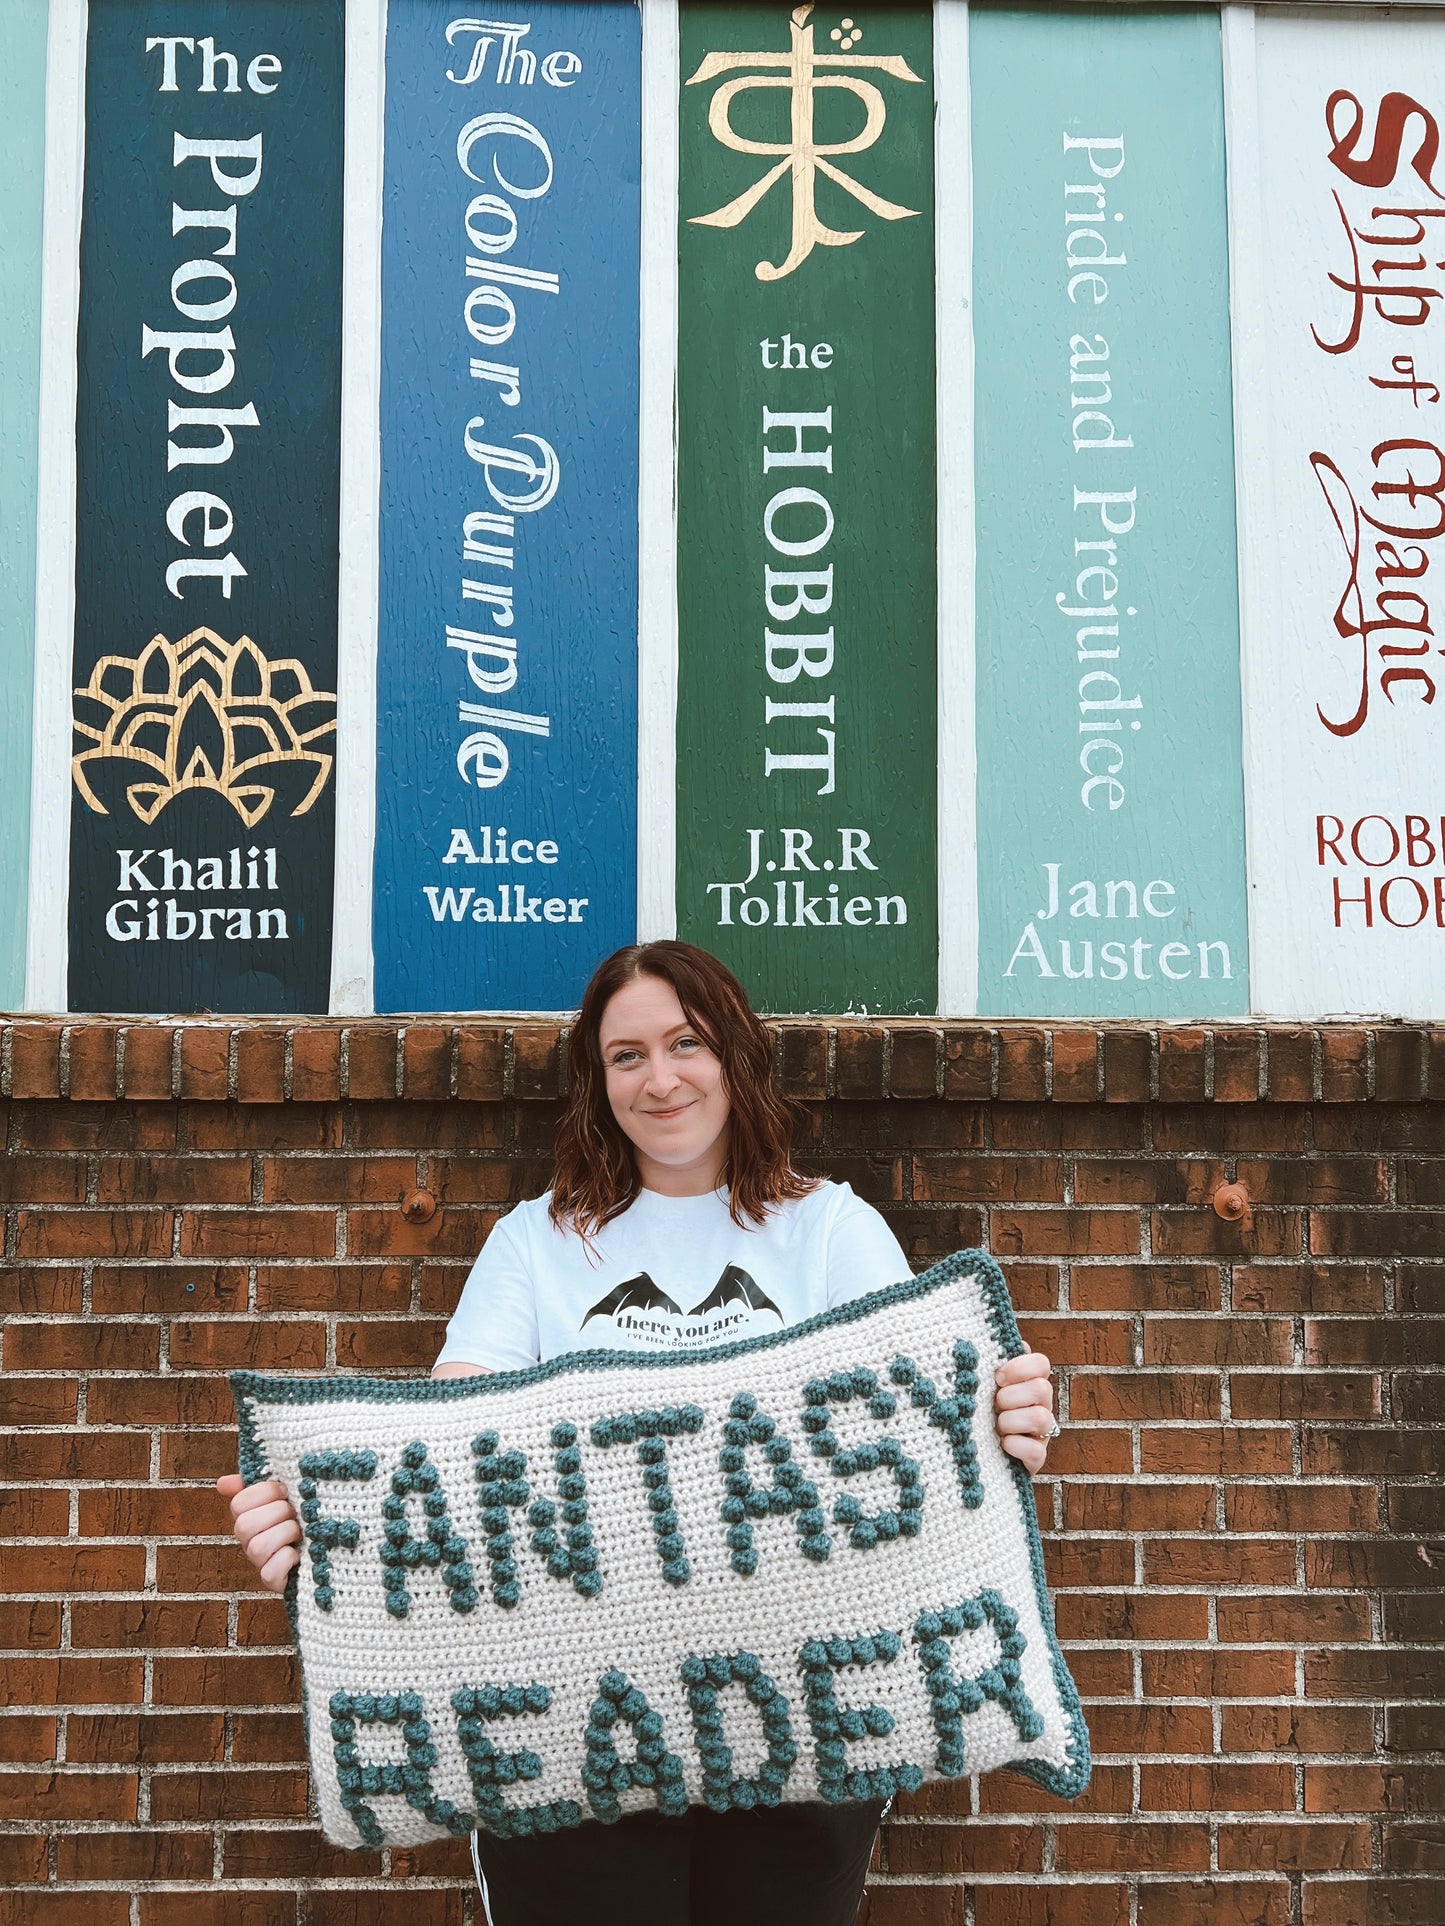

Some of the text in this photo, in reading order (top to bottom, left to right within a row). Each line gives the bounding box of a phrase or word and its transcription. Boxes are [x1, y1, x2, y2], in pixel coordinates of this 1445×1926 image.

[146, 37, 282, 94] The
[446, 18, 583, 88] The
[142, 132, 263, 600] Prophet
[760, 334, 834, 369] the
[1369, 355, 1441, 408] of
[446, 113, 560, 788] Color Purple
[1057, 132, 1143, 812] Pride and Prejudice
[763, 406, 836, 796] HOBBIT
[117, 846, 279, 892] Khalil
[443, 828, 559, 864] Alice
[744, 829, 879, 884] J.R.R
[424, 886, 589, 923] Walker
[706, 881, 908, 926] Tolkien
[1038, 863, 1176, 920] Jane
[106, 899, 289, 942] Gibran
[1004, 924, 1233, 981] Austen
[617, 1313, 750, 1341] there you are.
[645, 1335, 664, 1345] BEEN
[705, 1334, 720, 1343] FOR
[723, 1328, 739, 1336] YOU
[299, 1339, 984, 1618] FANTASY
[328, 1588, 1044, 1850] READER
